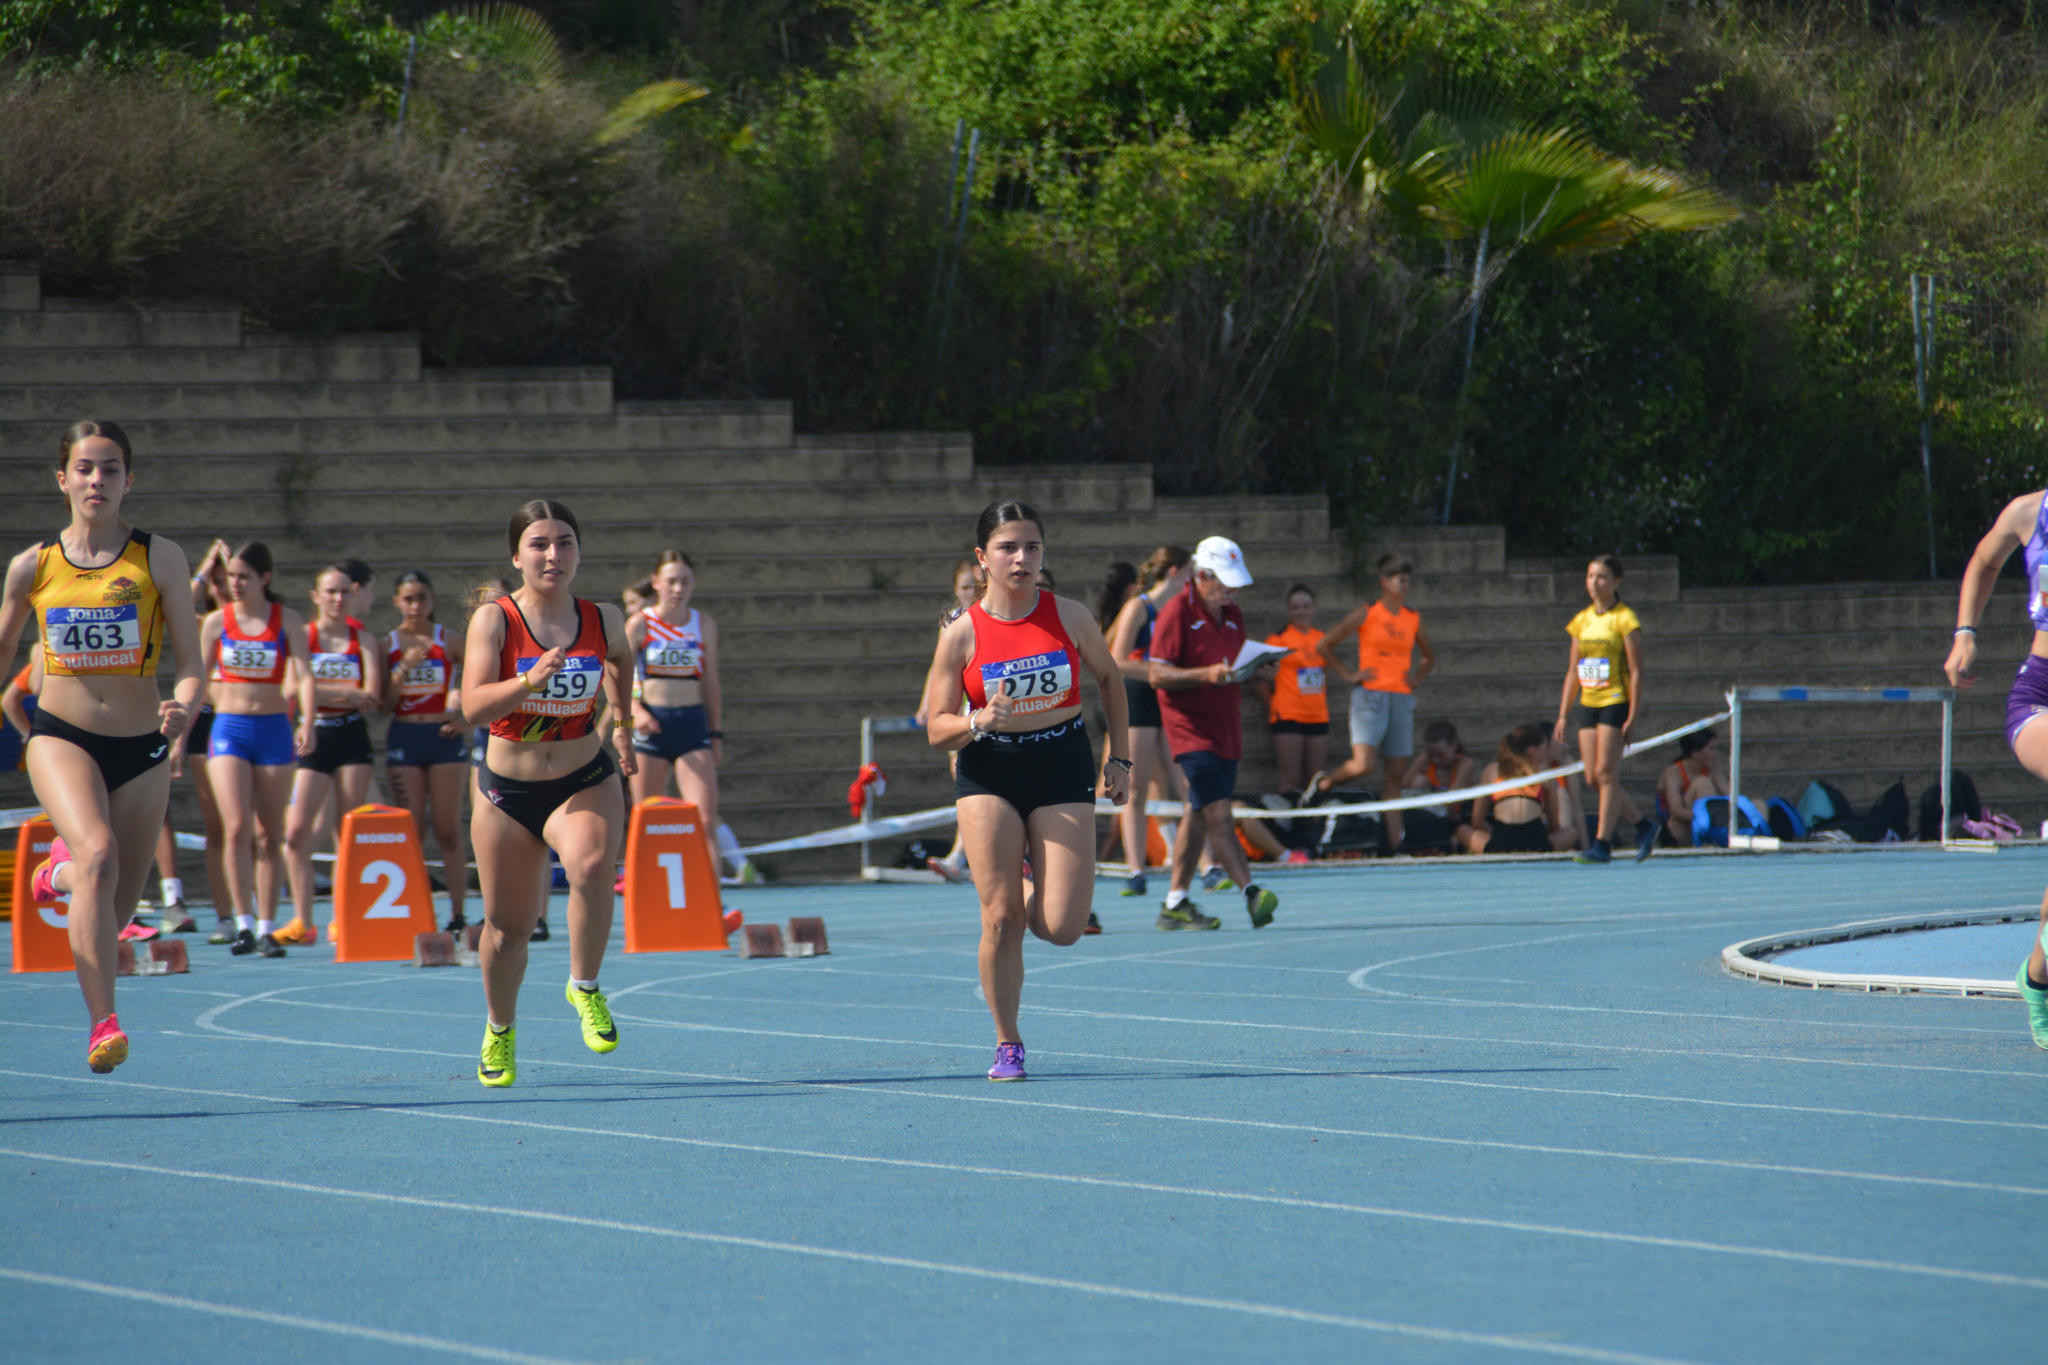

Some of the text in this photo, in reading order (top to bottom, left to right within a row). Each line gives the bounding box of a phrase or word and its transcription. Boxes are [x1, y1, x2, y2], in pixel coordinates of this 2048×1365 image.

[63, 624, 125, 651] 463
[231, 651, 266, 667] 332
[659, 651, 692, 666] 106
[315, 662, 352, 678] 456
[1003, 670, 1058, 700] 278
[646, 824, 695, 834] MONDO
[355, 832, 407, 844] MONDO
[360, 859, 411, 919] 2
[658, 853, 687, 910] 1
